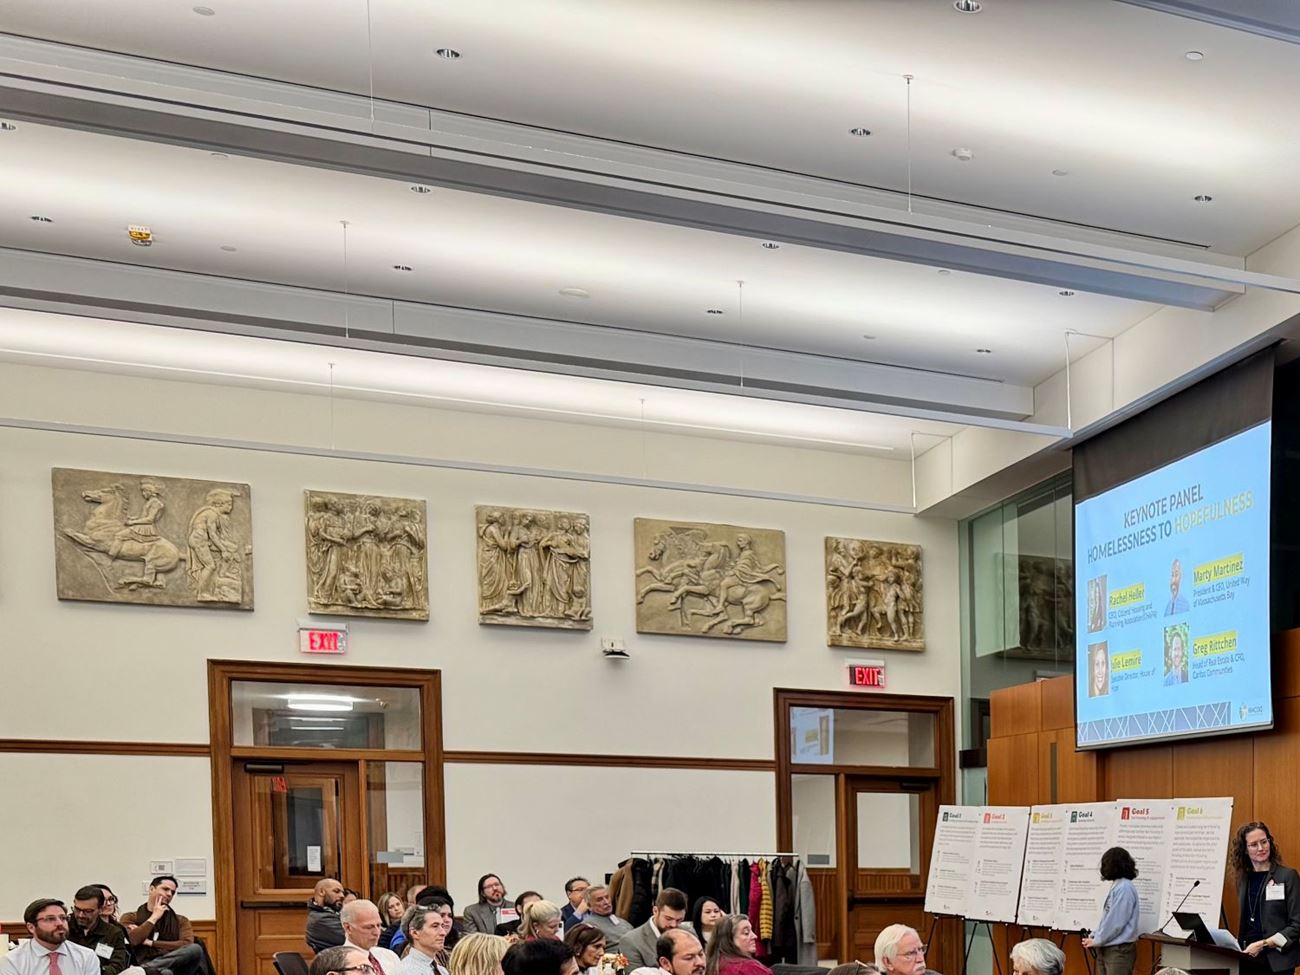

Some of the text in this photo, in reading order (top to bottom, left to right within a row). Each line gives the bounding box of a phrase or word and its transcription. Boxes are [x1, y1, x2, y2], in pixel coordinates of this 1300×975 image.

[1123, 483, 1204, 529] KEYNOTE PANEL
[1087, 489, 1253, 565] HOMELESSNESS TO HOPEFULNESS
[1193, 559, 1244, 583] Marty Martinez
[1192, 636, 1237, 656] Greg Rittchen
[855, 667, 880, 685] EXIT
[1131, 807, 1145, 815] Goal
